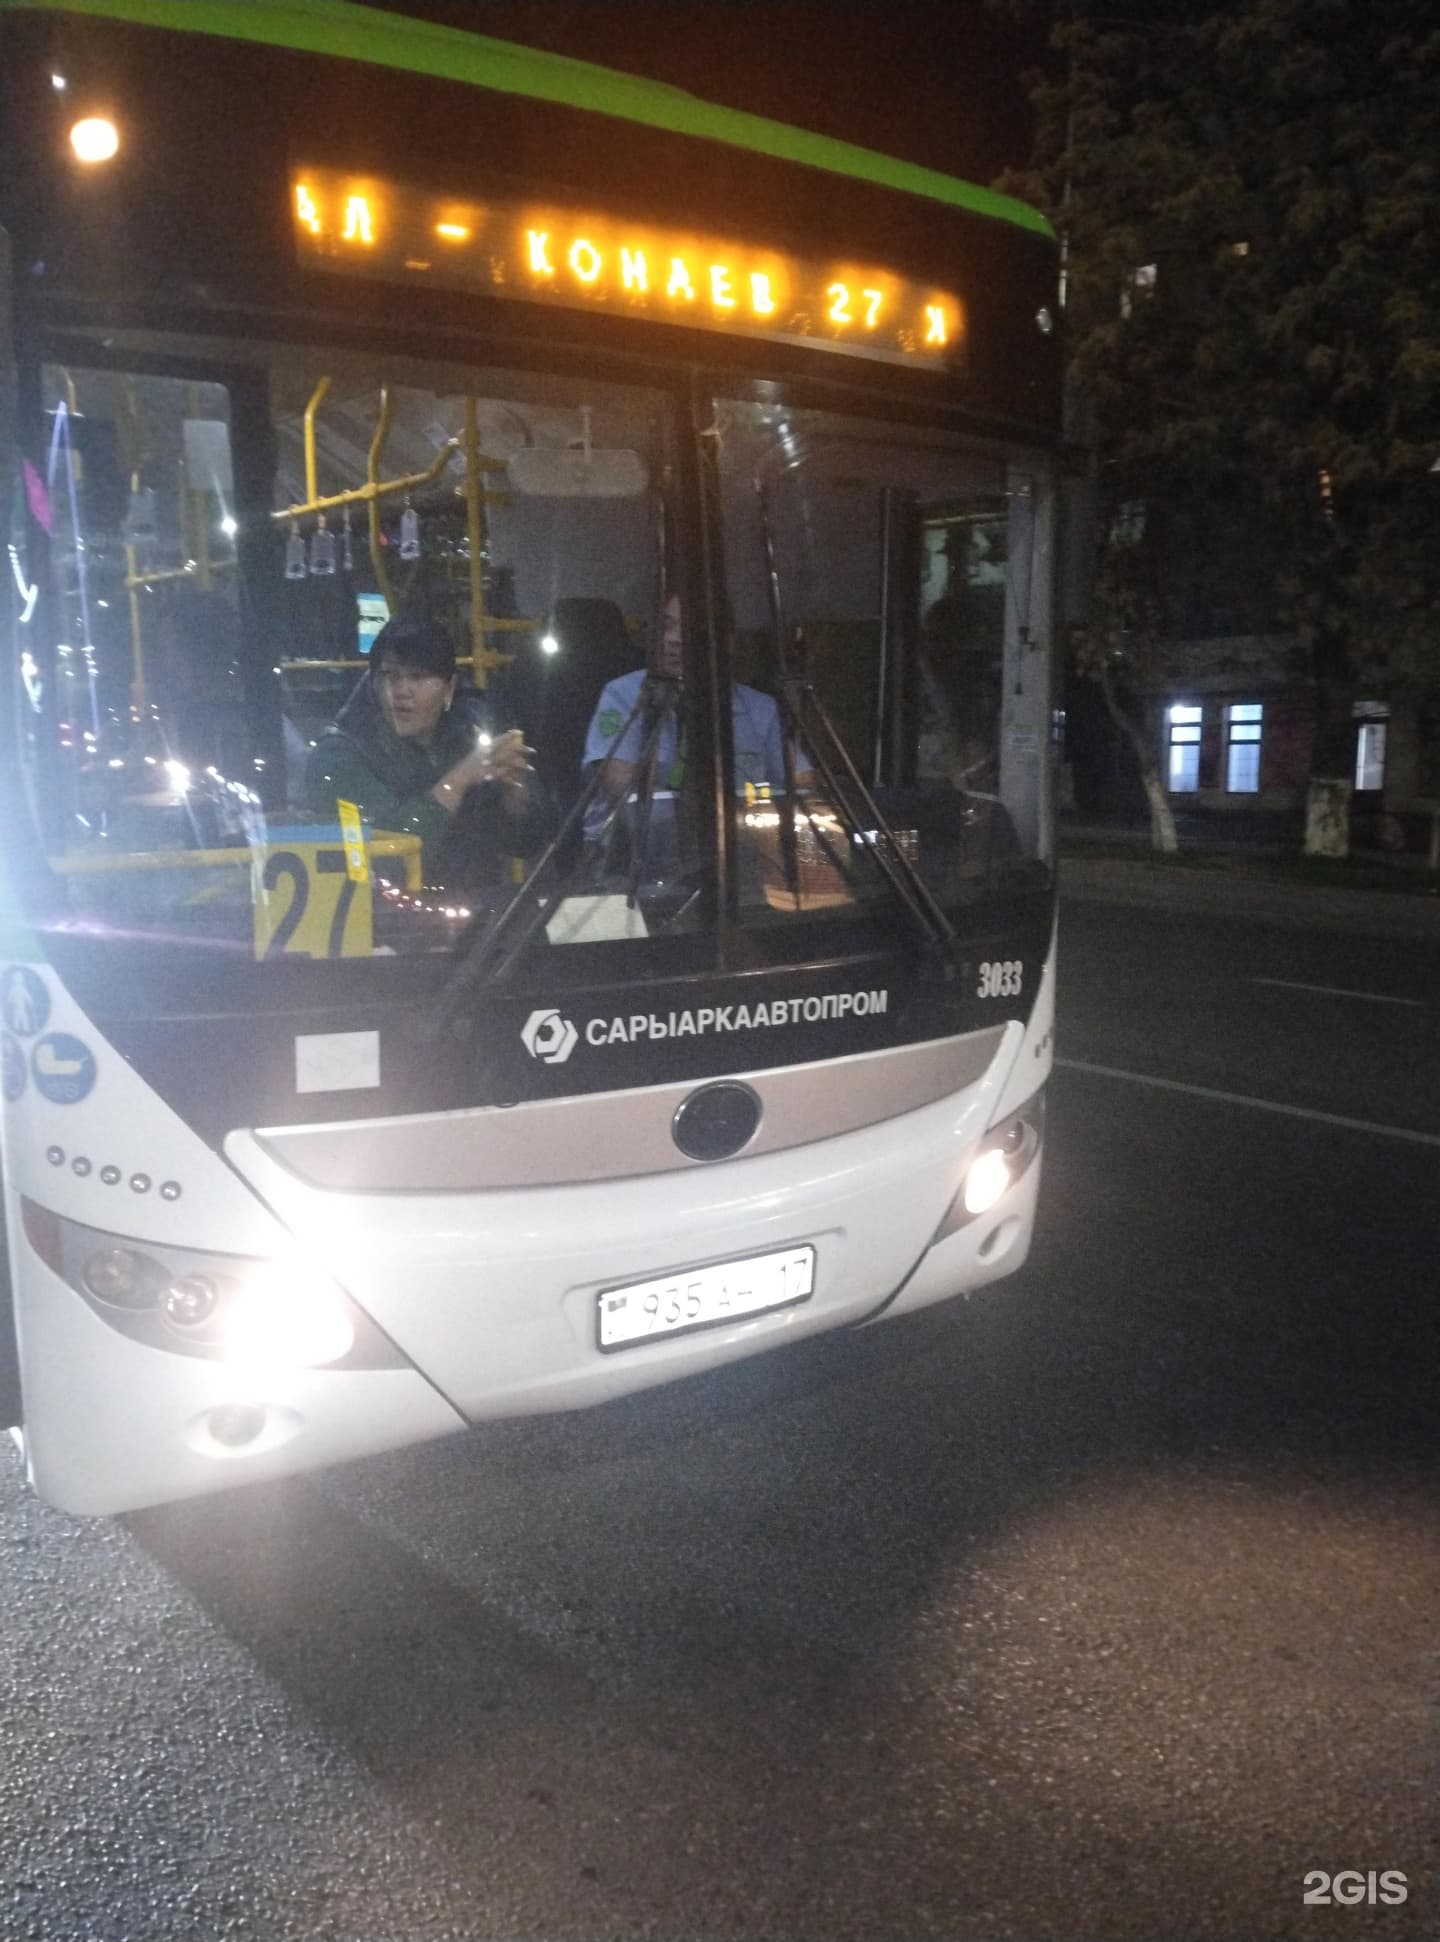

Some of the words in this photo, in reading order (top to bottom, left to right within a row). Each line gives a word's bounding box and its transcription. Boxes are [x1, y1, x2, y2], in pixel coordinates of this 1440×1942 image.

[526, 229, 776, 315] КОНАЕВ
[827, 282, 883, 329] 27
[262, 850, 359, 960] 27
[976, 959, 1024, 999] 3033
[585, 988, 888, 1046] САРЫАРКААВТОПРОМ
[642, 1282, 704, 1330] 935
